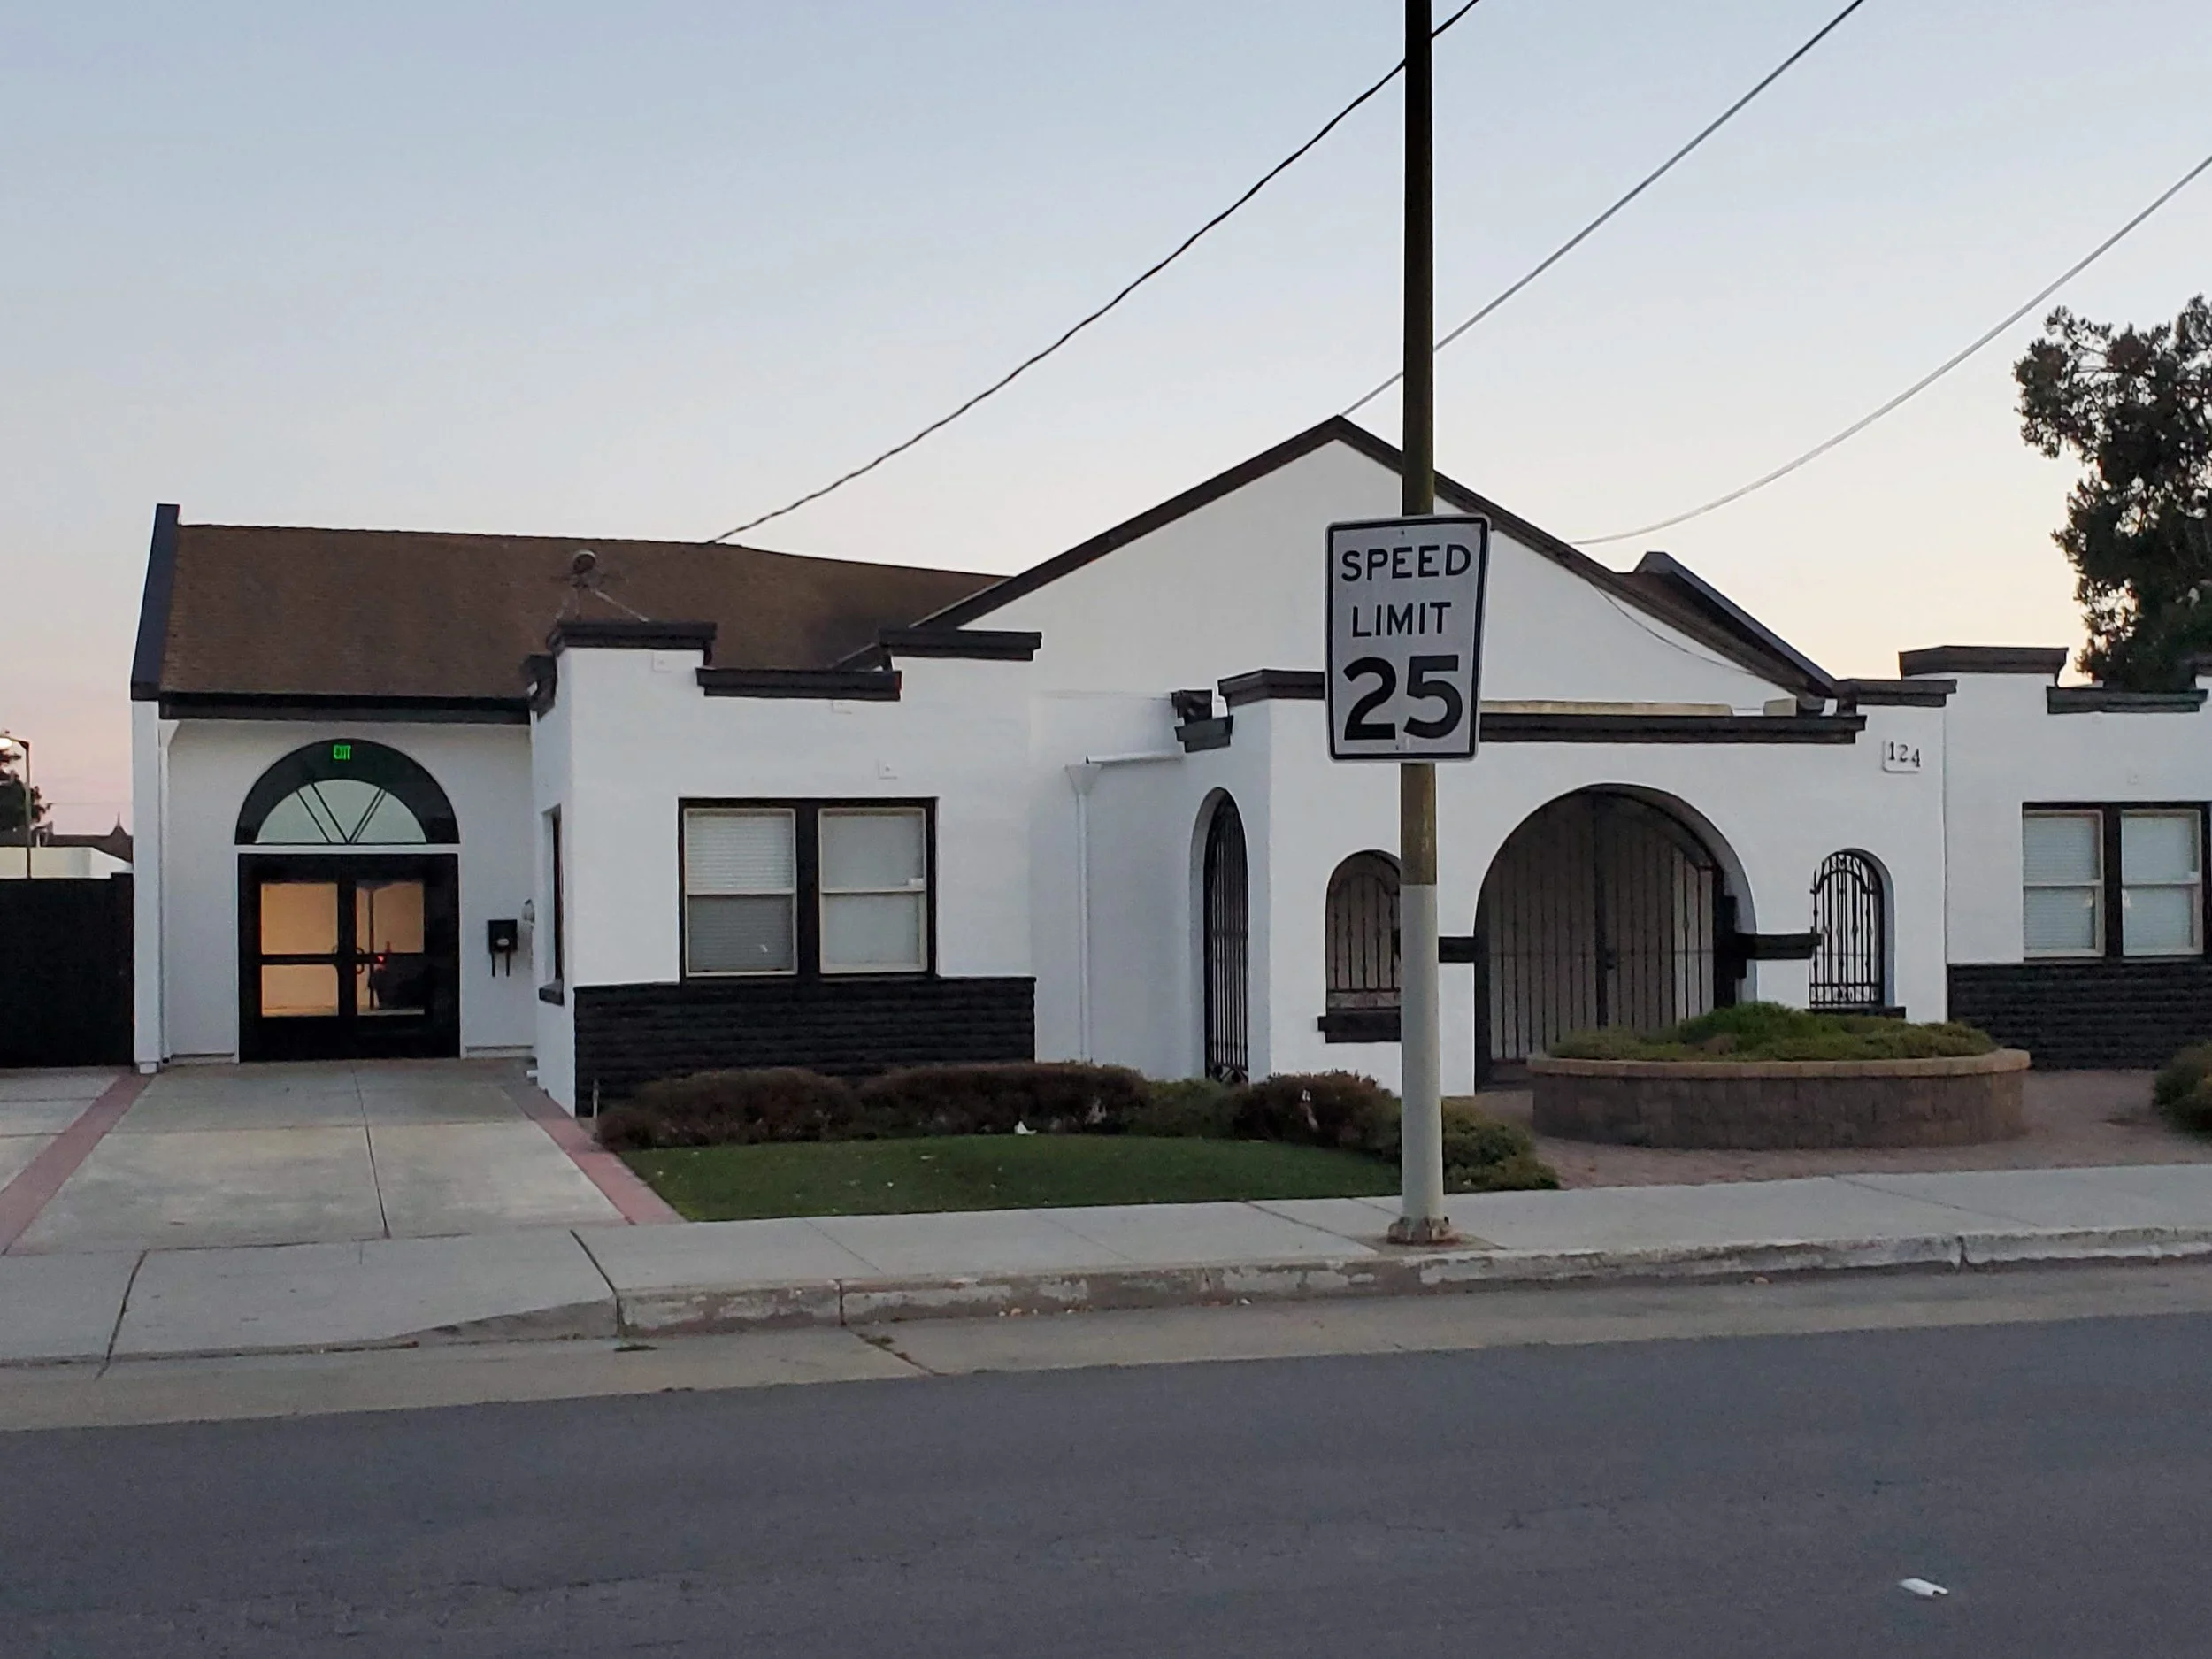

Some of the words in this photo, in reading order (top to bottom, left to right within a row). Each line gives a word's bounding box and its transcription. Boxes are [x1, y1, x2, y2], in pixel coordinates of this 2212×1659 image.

[1341, 544, 1471, 581] SPEED
[1352, 602, 1452, 637] LIMIT
[1342, 654, 1463, 741] 25
[1888, 741, 1921, 767] 124
